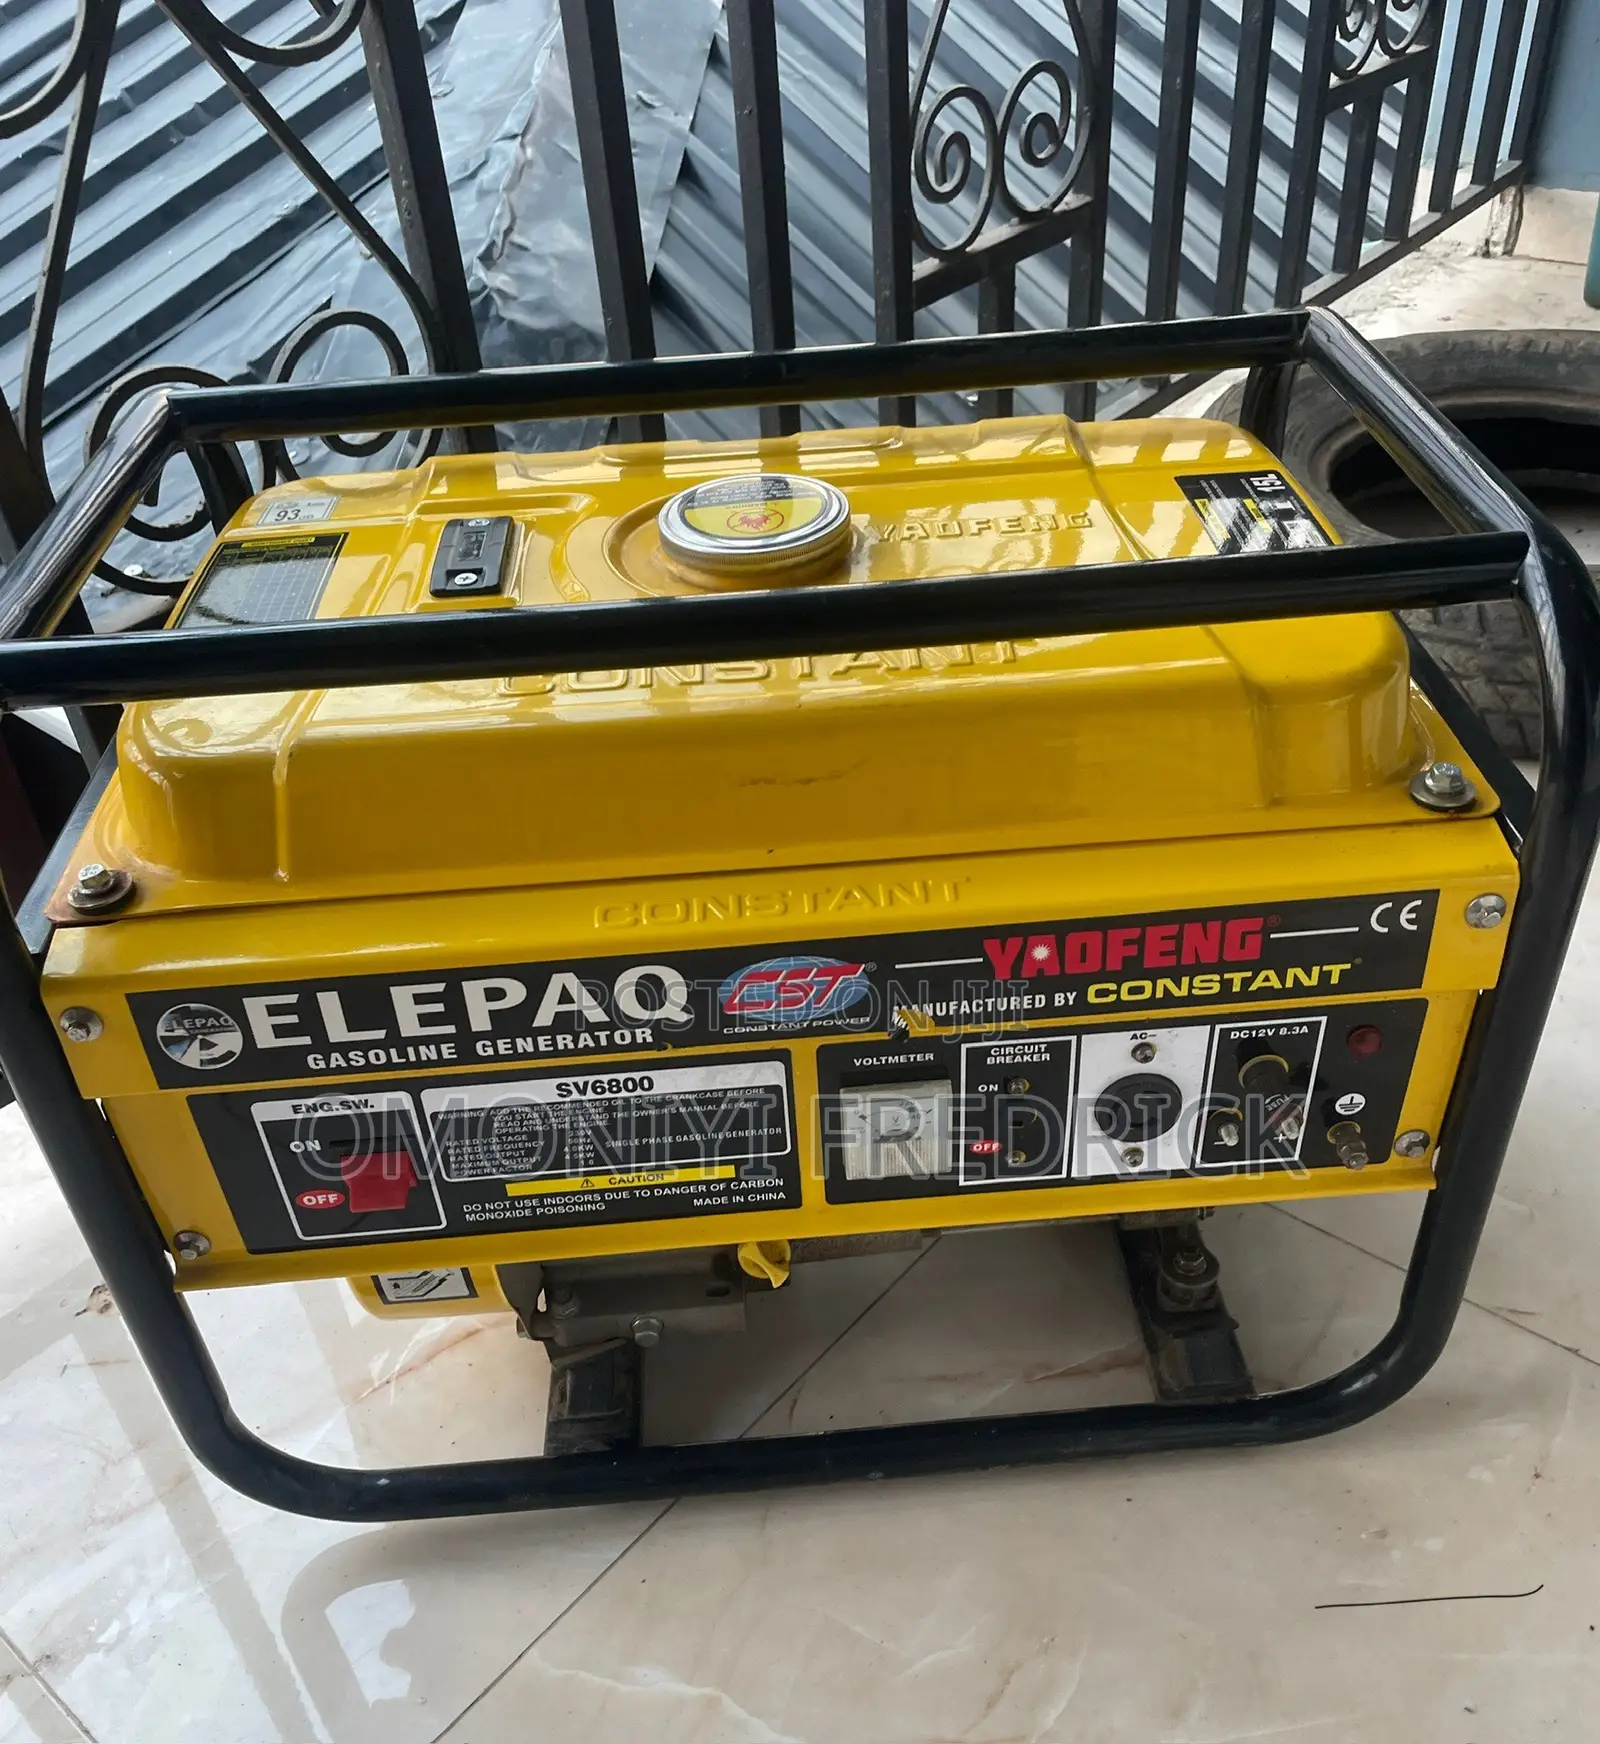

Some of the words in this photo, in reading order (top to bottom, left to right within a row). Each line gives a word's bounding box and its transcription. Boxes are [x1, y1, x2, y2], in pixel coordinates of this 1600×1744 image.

[1250, 473, 1286, 492] 15L
[275, 509, 301, 522] 93
[877, 511, 1094, 543] YAOFENG
[594, 876, 972, 929] CONSTANT
[1370, 899, 1423, 933] CE
[983, 916, 1265, 981] YAOFENG
[723, 963, 866, 1015] CST
[1054, 990, 1078, 1007] BY
[1086, 962, 1353, 1005] CONSTANT
[241, 964, 695, 1050] ELEPAQ
[723, 1020, 811, 1035] CONSTANT
[812, 1016, 871, 1028] POWER
[1230, 1028, 1275, 1040] DC12V
[1279, 1025, 1309, 1036] 8.3A
[306, 1042, 458, 1070] GASOLINE
[475, 1027, 654, 1057] GENERATOR
[990, 1043, 1048, 1055] CIRCUIT
[853, 1053, 935, 1067] VOLTMETER
[986, 1053, 1051, 1066] BREAKER
[555, 1075, 655, 1098] SV6800
[978, 1084, 999, 1093] ON
[291, 1098, 375, 1115] ENG.SW.
[513, 1106, 531, 1114] THE
[611, 1098, 626, 1106] OIL
[630, 1097, 642, 1105] TO
[665, 1091, 725, 1101] CRANKCASE
[726, 1088, 765, 1097] BEFORE
[523, 1119, 543, 1127] AND
[612, 1111, 630, 1119] THE
[679, 1104, 719, 1113] MANUAL
[720, 1101, 760, 1110] BEFORE
[495, 1124, 551, 1135] OPERATING
[552, 1122, 571, 1130] THE
[642, 1135, 674, 1146] PHASE
[676, 1131, 724, 1143] GASOLINE
[725, 1127, 783, 1139] GENERATOR
[289, 1139, 322, 1153] ON
[481, 1134, 529, 1144] VOLTAGE
[483, 1140, 546, 1152] FREQUENCY
[973, 1142, 1000, 1152] OFF
[608, 1173, 665, 1186] CAUTION
[302, 1193, 339, 1206] OFF
[463, 1202, 482, 1213] DO
[485, 1200, 511, 1211] NOT
[515, 1198, 541, 1208] USE
[543, 1192, 602, 1206] INDOORS
[604, 1190, 630, 1201] DUE
[634, 1188, 651, 1198] TO
[654, 1184, 707, 1197] DANGER
[710, 1182, 727, 1192] OF
[730, 1177, 784, 1191] CARBON
[693, 1195, 729, 1207] MADE
[732, 1193, 744, 1204] IN
[747, 1191, 787, 1203] CHINA
[465, 1210, 533, 1222] MONOXIDE
[536, 1202, 606, 1216] POISONING
